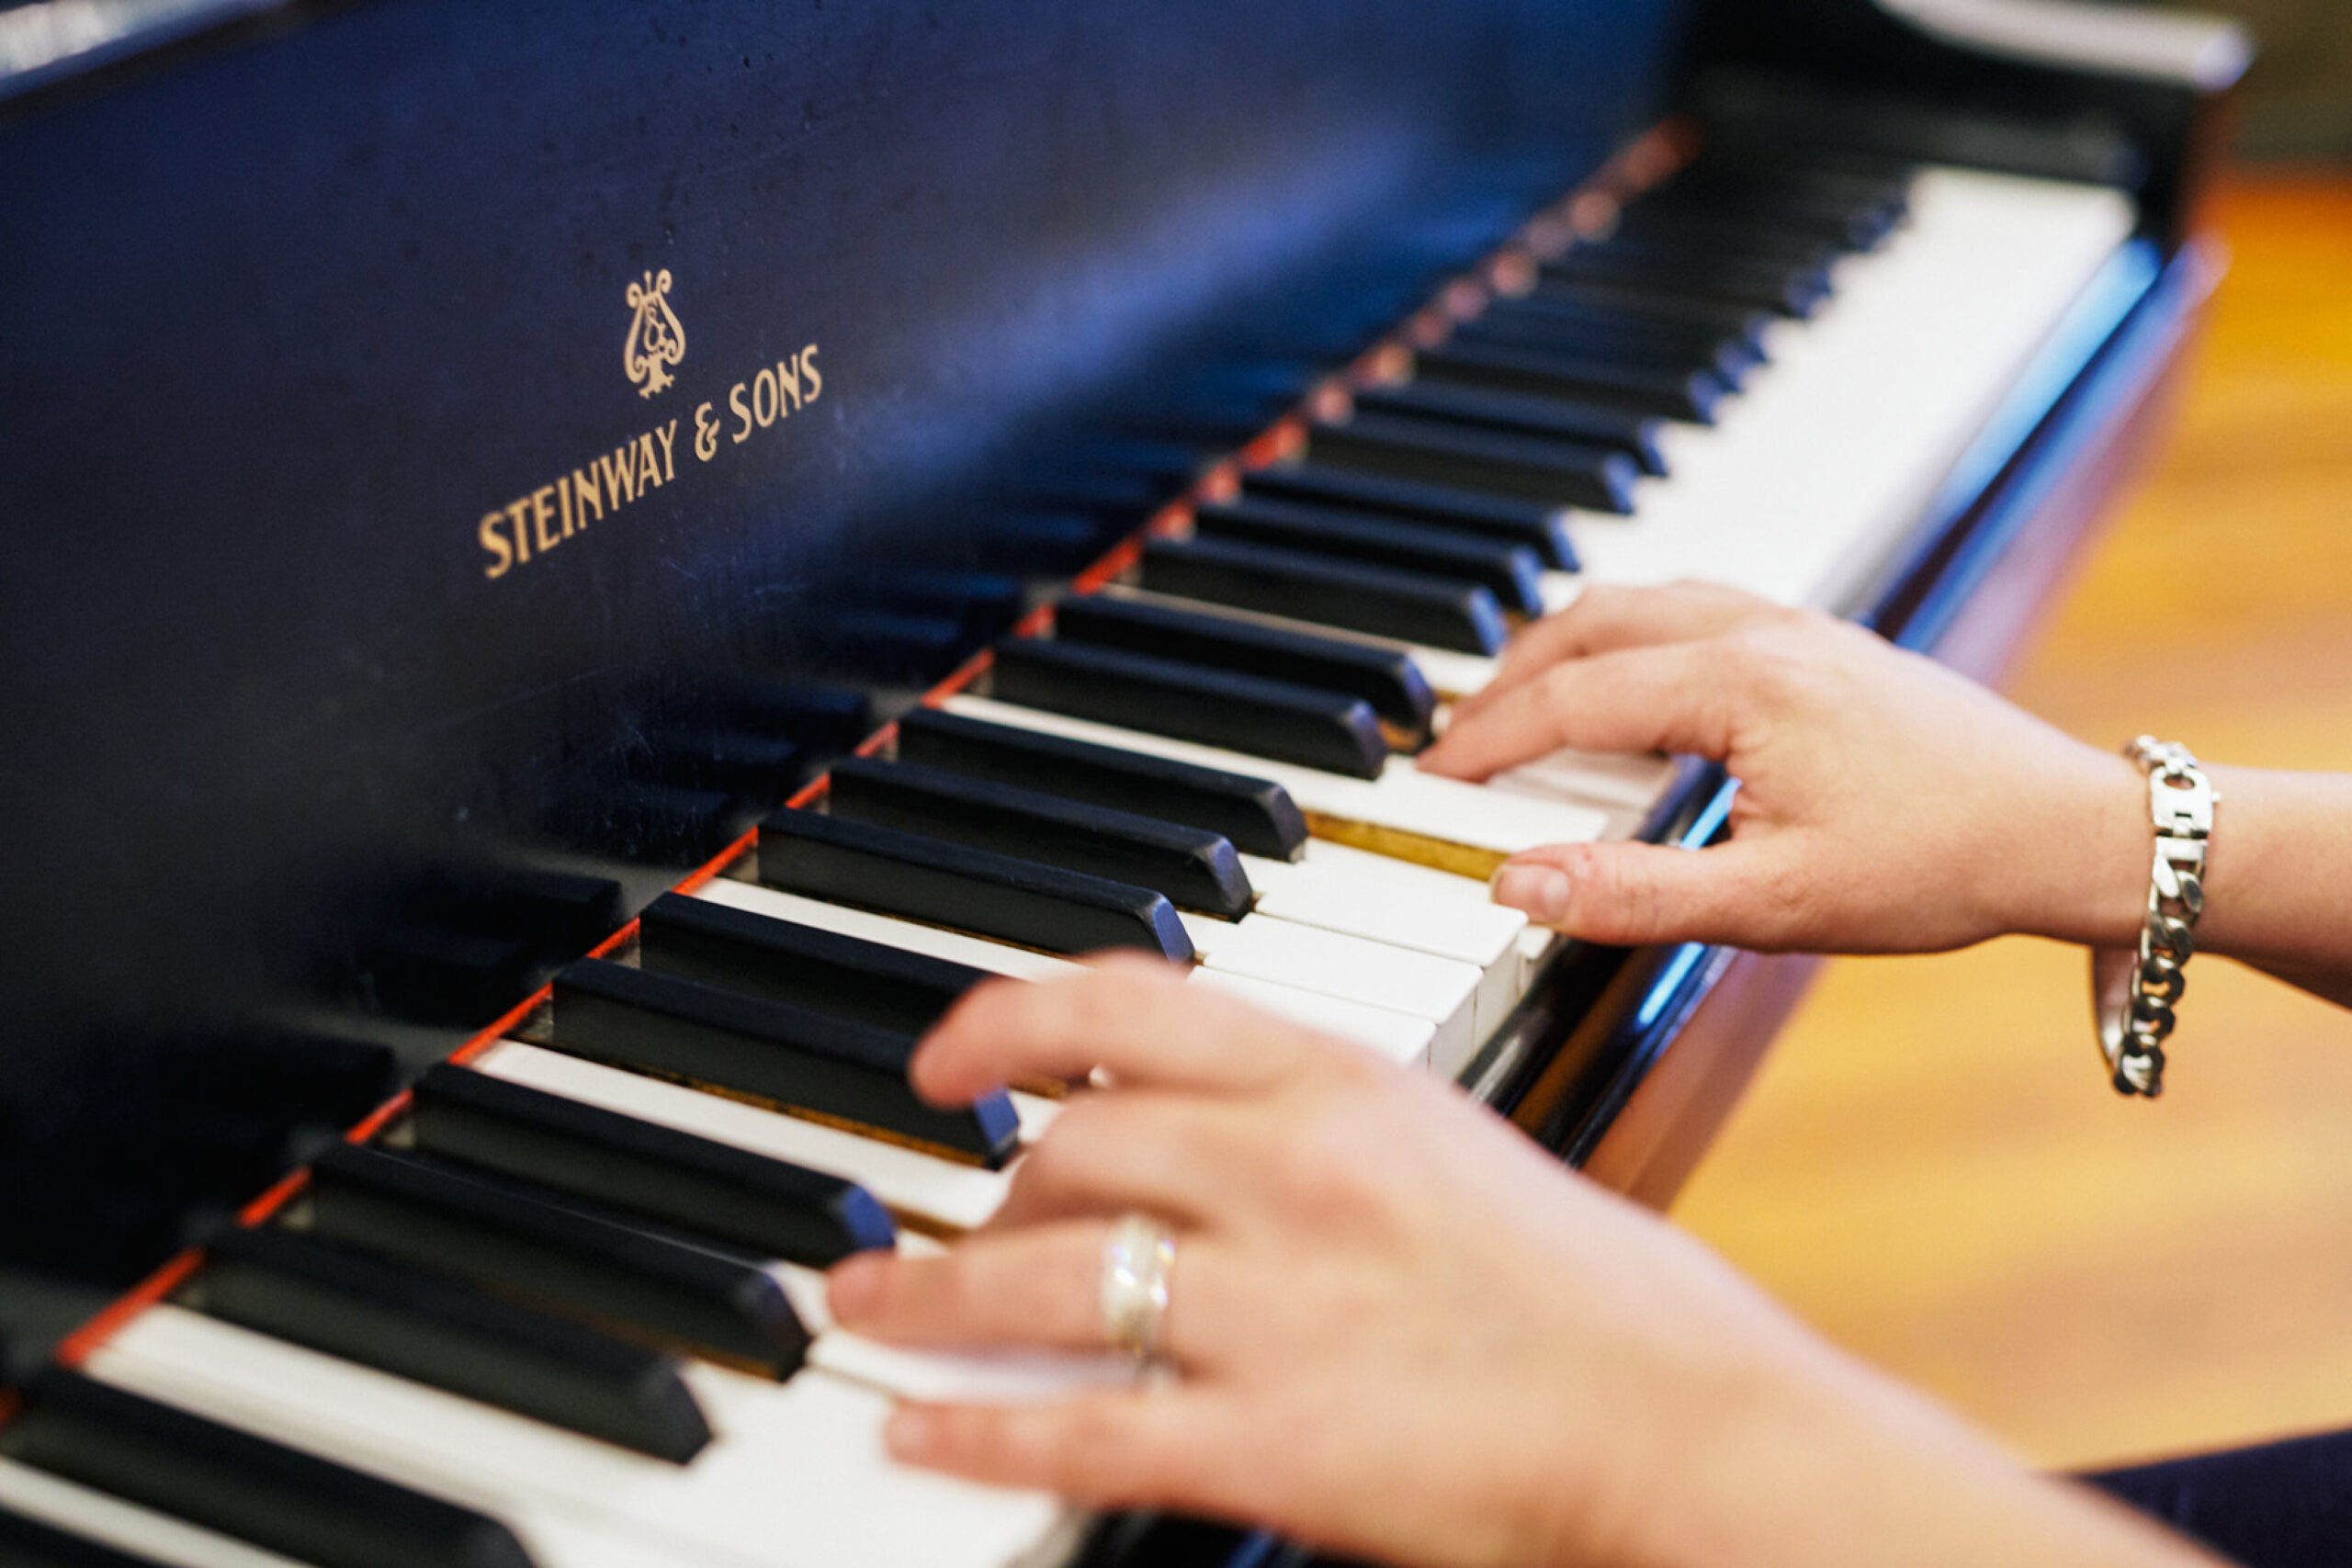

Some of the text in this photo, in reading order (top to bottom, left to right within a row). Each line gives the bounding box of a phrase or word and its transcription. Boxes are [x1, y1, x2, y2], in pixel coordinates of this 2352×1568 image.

[479, 344, 822, 579] STEINWAY & SONS
